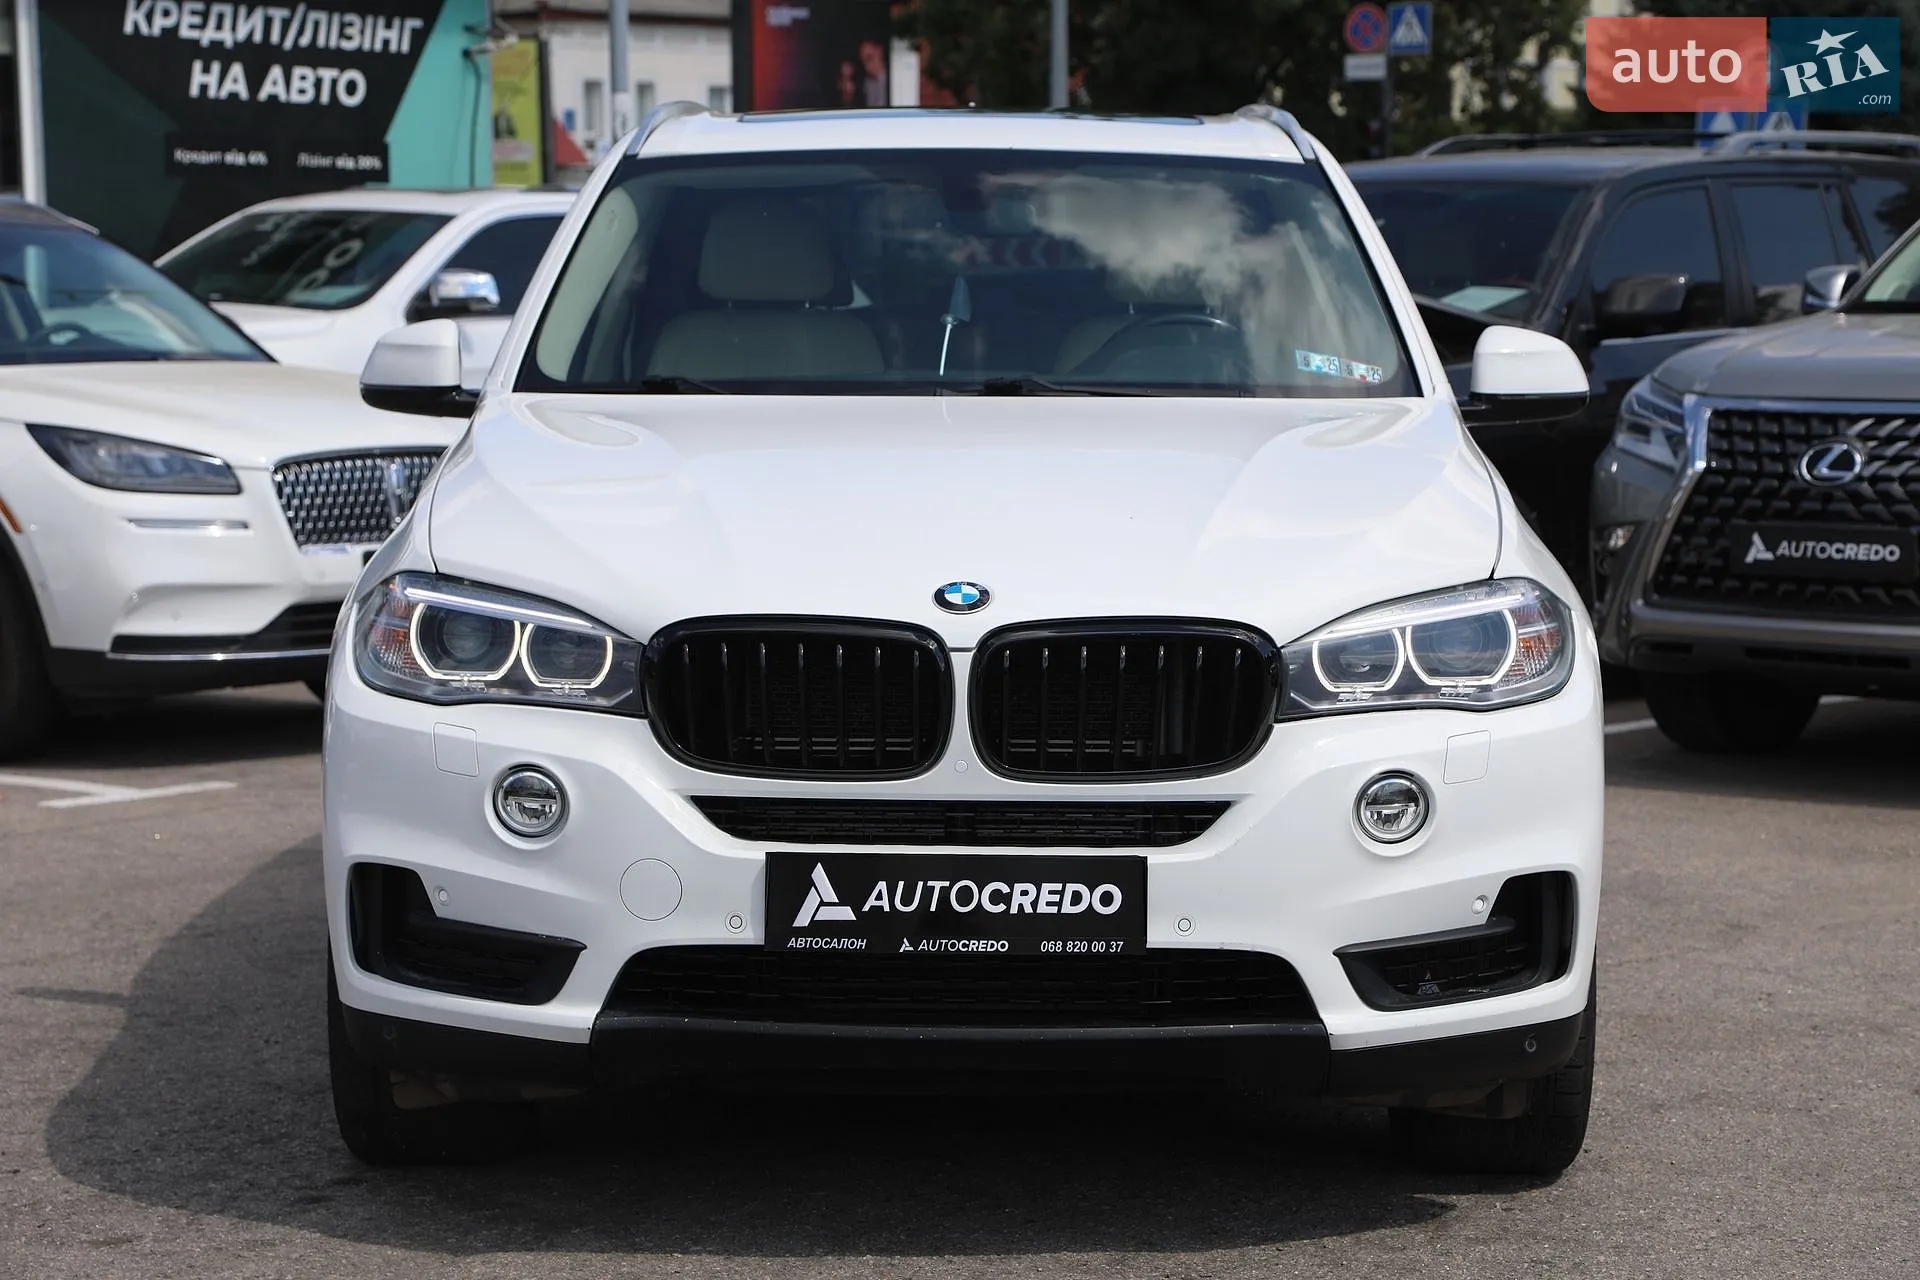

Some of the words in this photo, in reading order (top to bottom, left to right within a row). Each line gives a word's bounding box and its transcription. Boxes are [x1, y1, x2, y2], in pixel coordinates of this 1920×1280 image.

[123, 0, 424, 54] КРЕДИТ/ЛІЗІНГ
[188, 59, 250, 101] НА
[256, 64, 368, 107] АВТО
[1776, 540, 1901, 562] AUTOCREDO
[861, 879, 1123, 915] AUTOCREDO
[787, 936, 867, 950] АВТОСАЛОН
[917, 938, 1009, 952] AUTOCREDO
[1040, 940, 1063, 953] 068
[1066, 941, 1089, 953] 820
[1091, 941, 1107, 953] 00
[1109, 941, 1124, 953] 37
